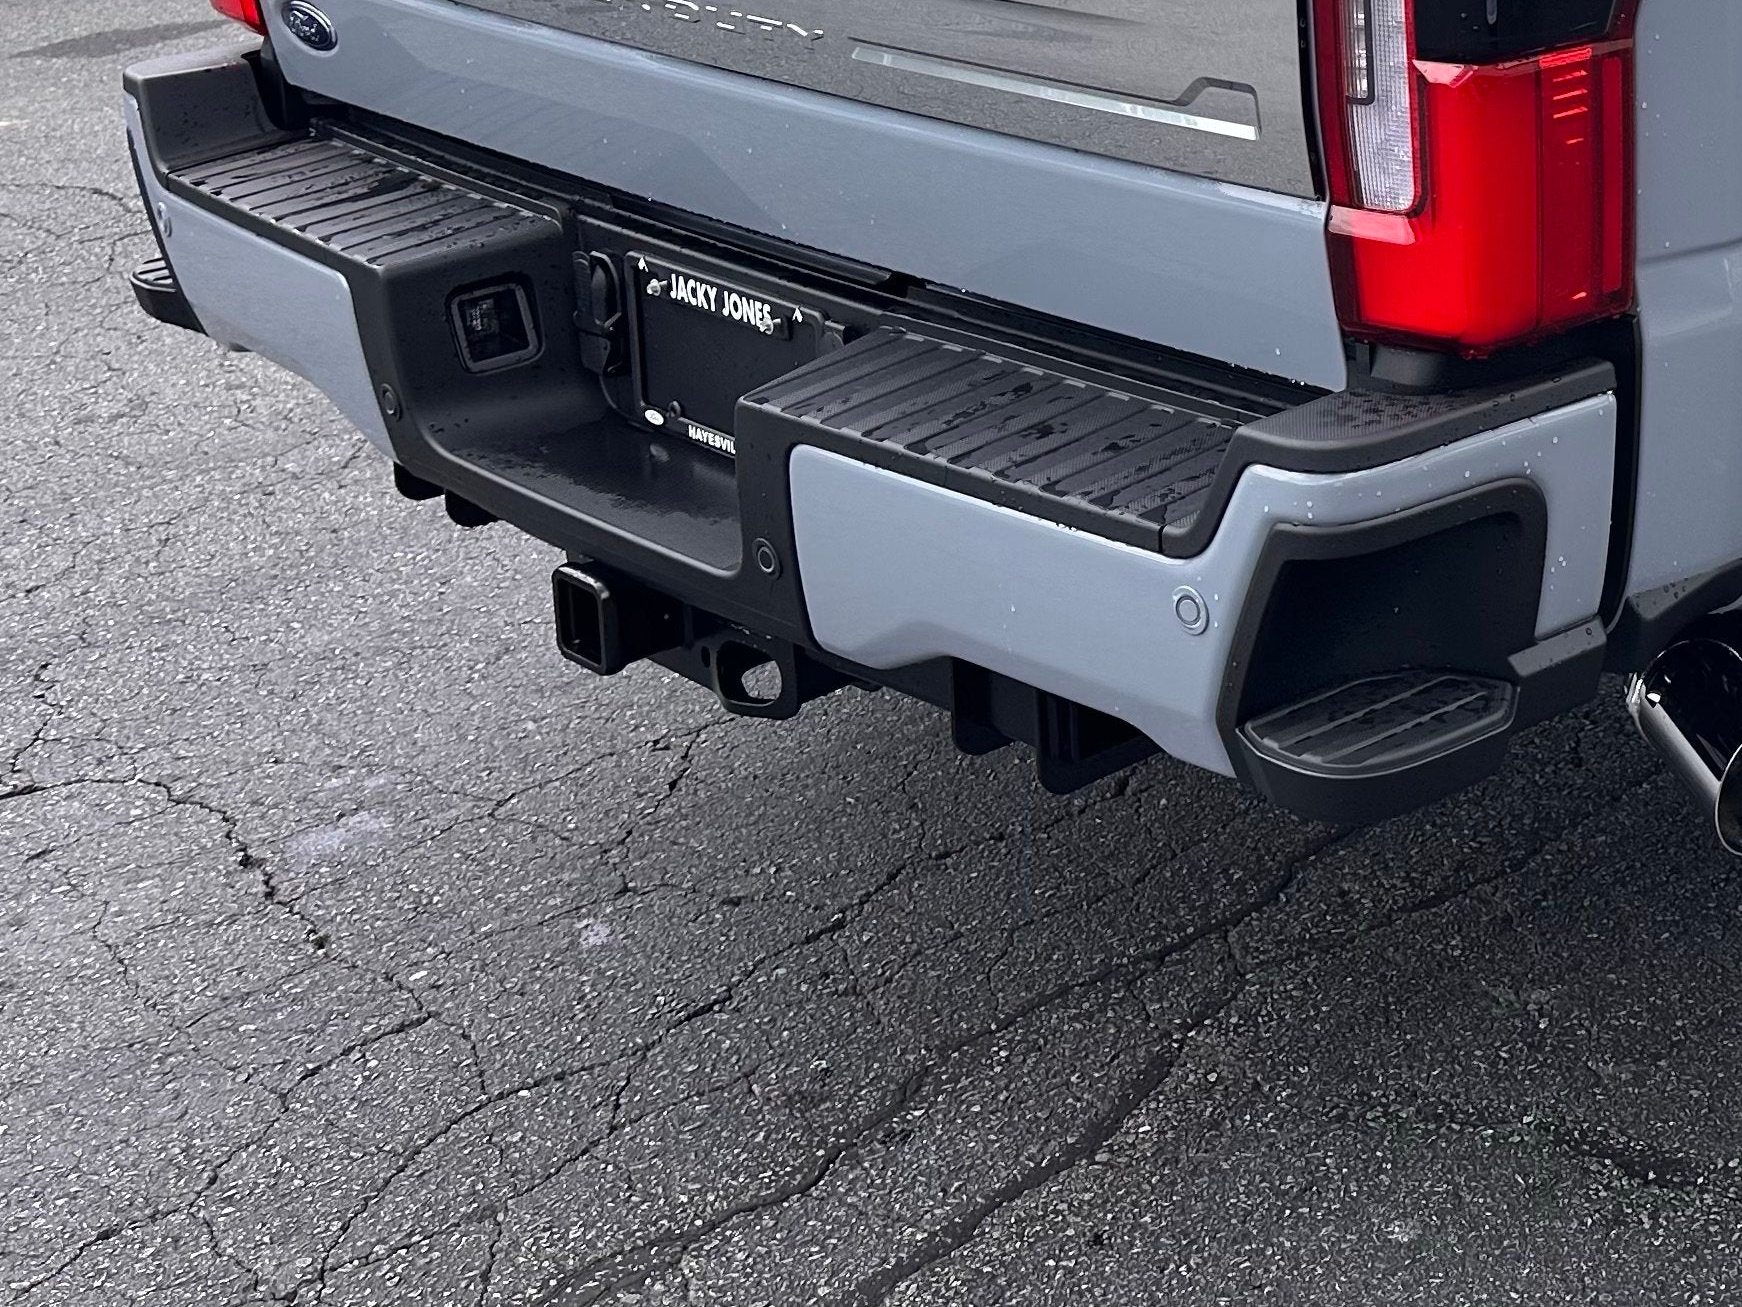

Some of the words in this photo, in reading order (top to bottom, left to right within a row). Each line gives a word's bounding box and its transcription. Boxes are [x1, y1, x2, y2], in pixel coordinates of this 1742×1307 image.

[669, 273, 718, 312] JACKY
[721, 291, 772, 331] JONES
[687, 424, 737, 455] HAYESVIL
